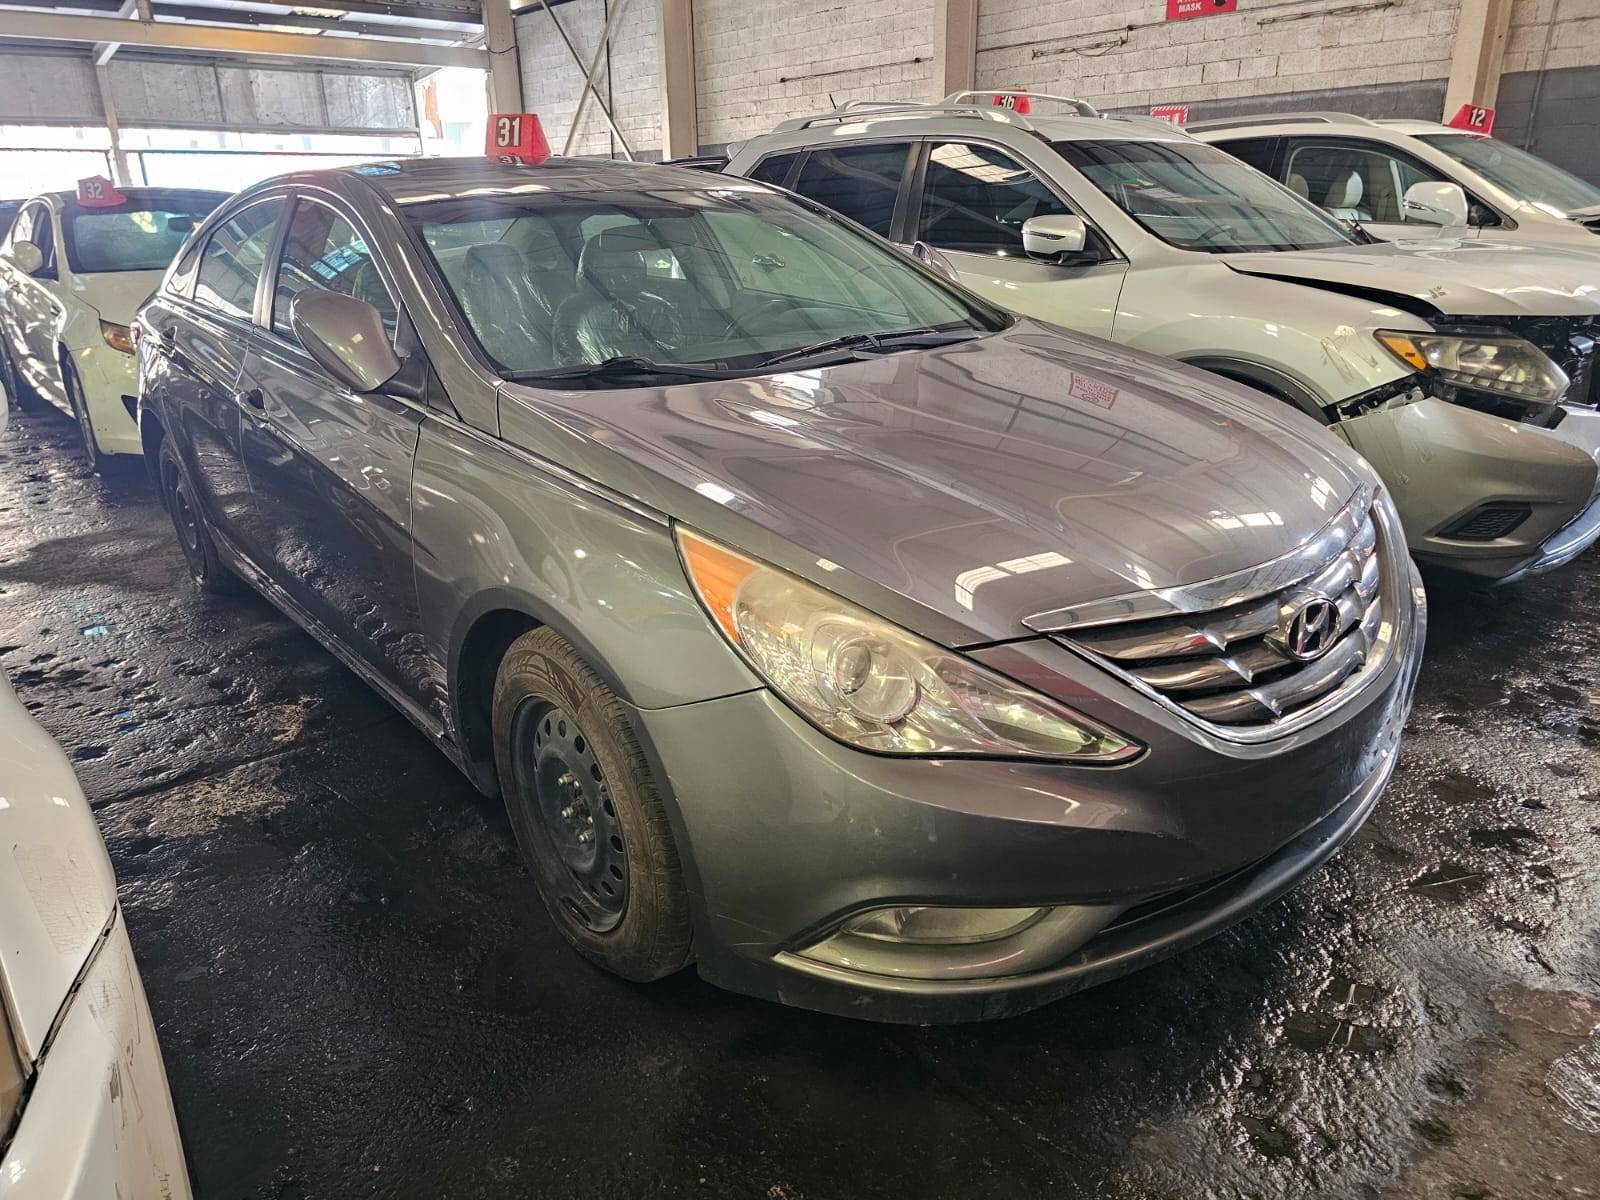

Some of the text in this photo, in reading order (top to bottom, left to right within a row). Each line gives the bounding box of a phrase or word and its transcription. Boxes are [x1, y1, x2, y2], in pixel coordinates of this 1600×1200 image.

[1178, 2, 1202, 13] MASK
[1470, 108, 1486, 127] 12
[498, 117, 520, 147] 31
[86, 182, 104, 199] 32
